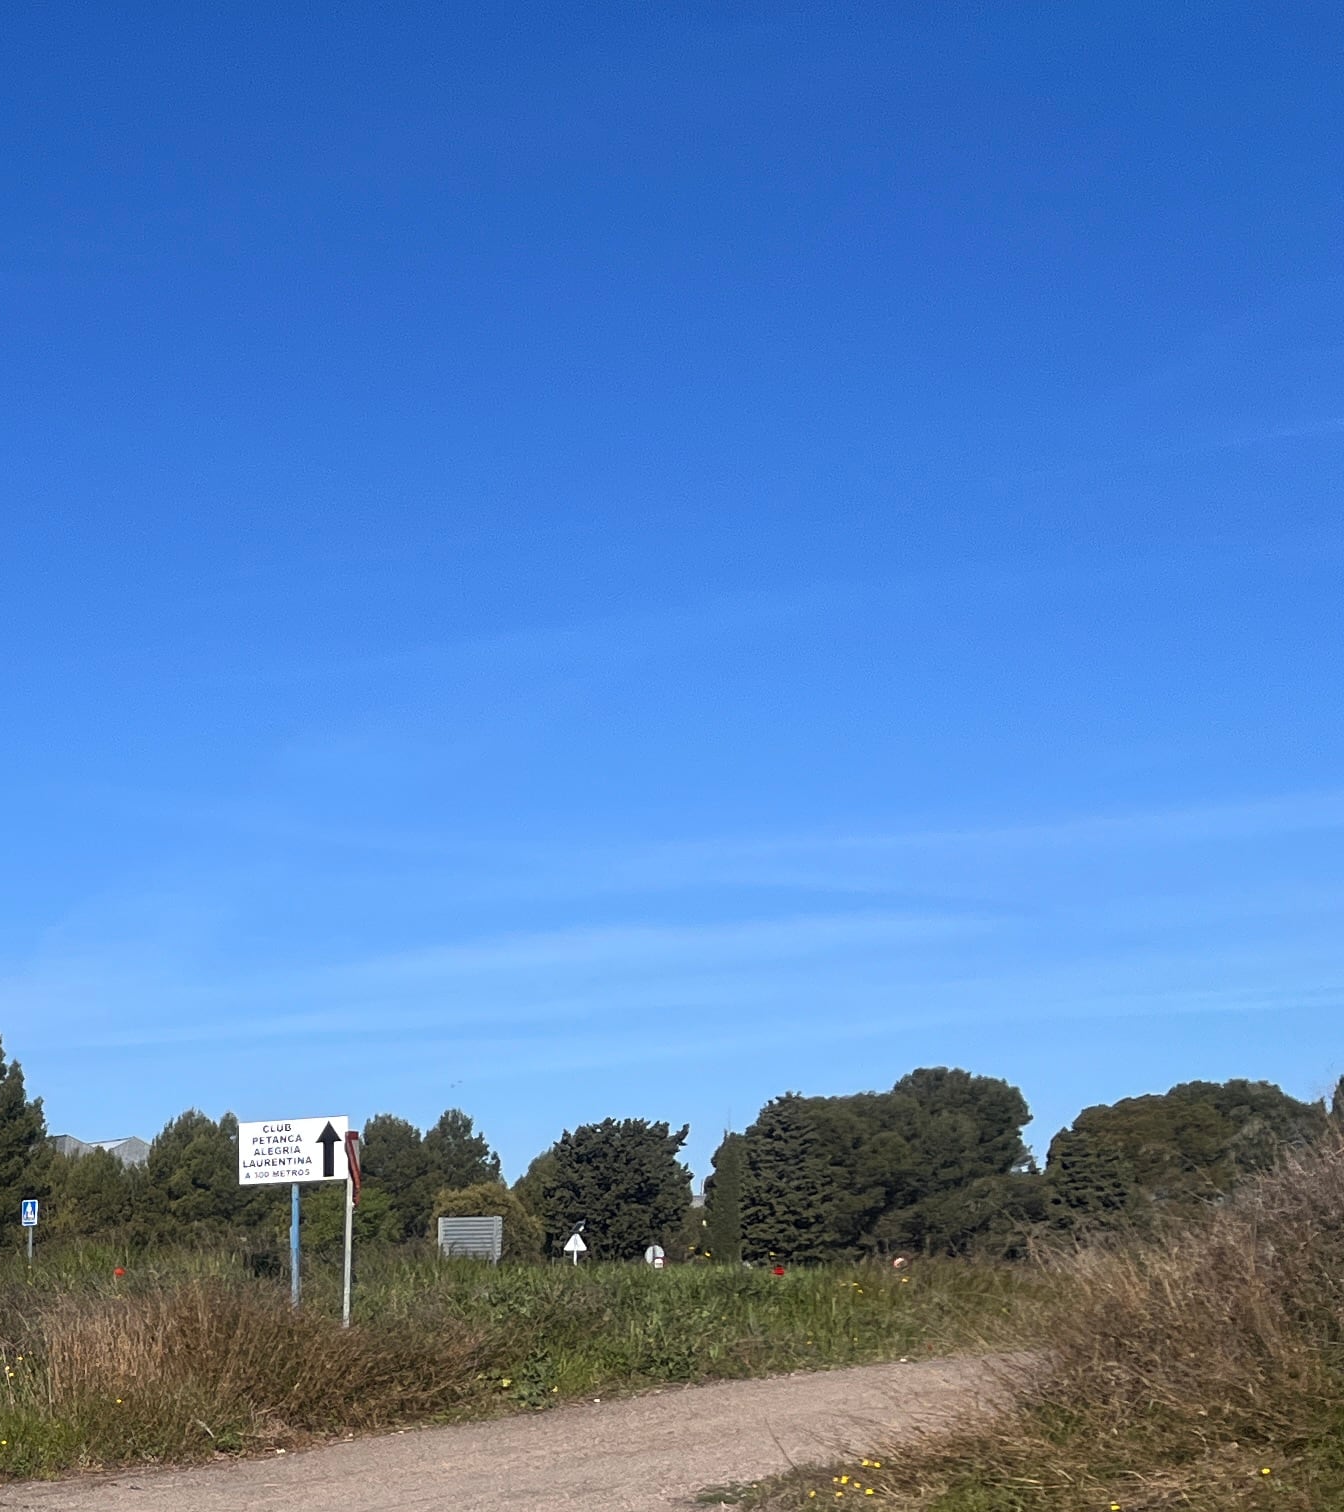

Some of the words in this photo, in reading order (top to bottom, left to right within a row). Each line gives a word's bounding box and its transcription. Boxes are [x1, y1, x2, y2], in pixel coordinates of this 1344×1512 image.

[262, 1123, 292, 1134] CLUB
[252, 1134, 303, 1145] PETANCA
[253, 1145, 301, 1156] ALEGRIA
[242, 1156, 313, 1168] LAURENTINA
[272, 1168, 311, 1178] METROS
